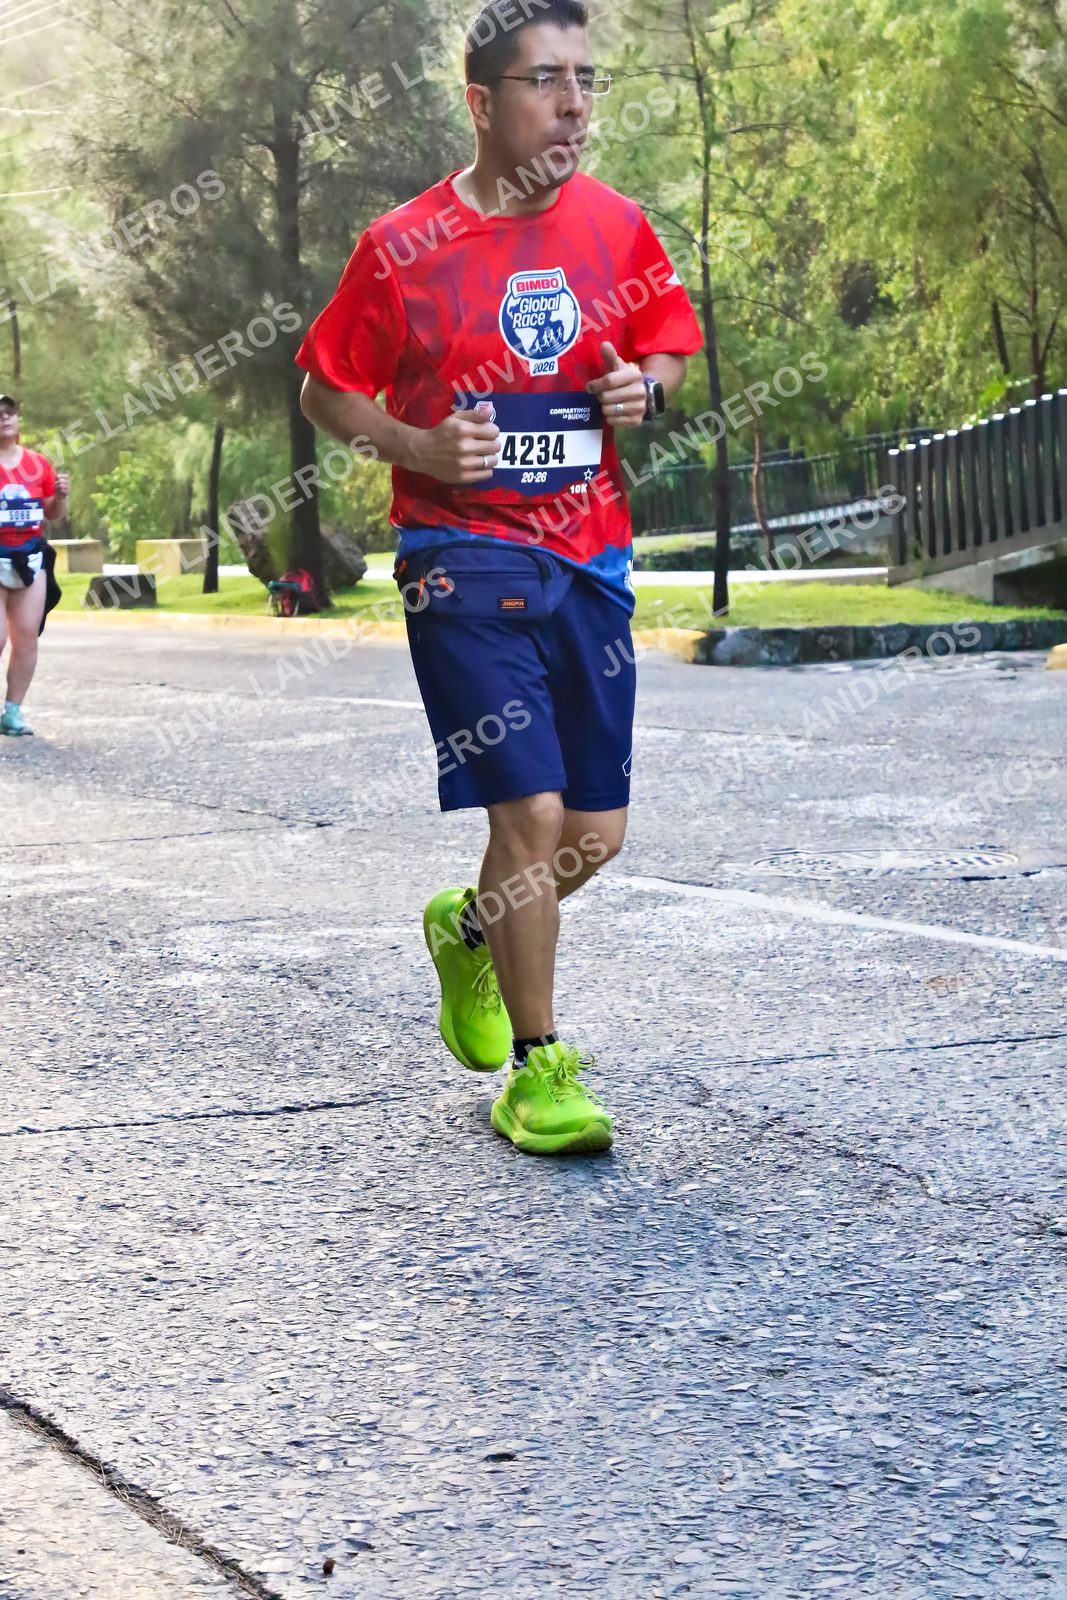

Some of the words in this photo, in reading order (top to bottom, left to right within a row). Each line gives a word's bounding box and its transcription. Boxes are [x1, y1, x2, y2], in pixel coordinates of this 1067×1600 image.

[515, 278, 559, 292] BIMBO
[520, 294, 559, 314] Global
[512, 312, 546, 329] Race
[532, 361, 555, 374] 2026
[501, 434, 565, 466] 4234
[569, 484, 588, 494] 10K
